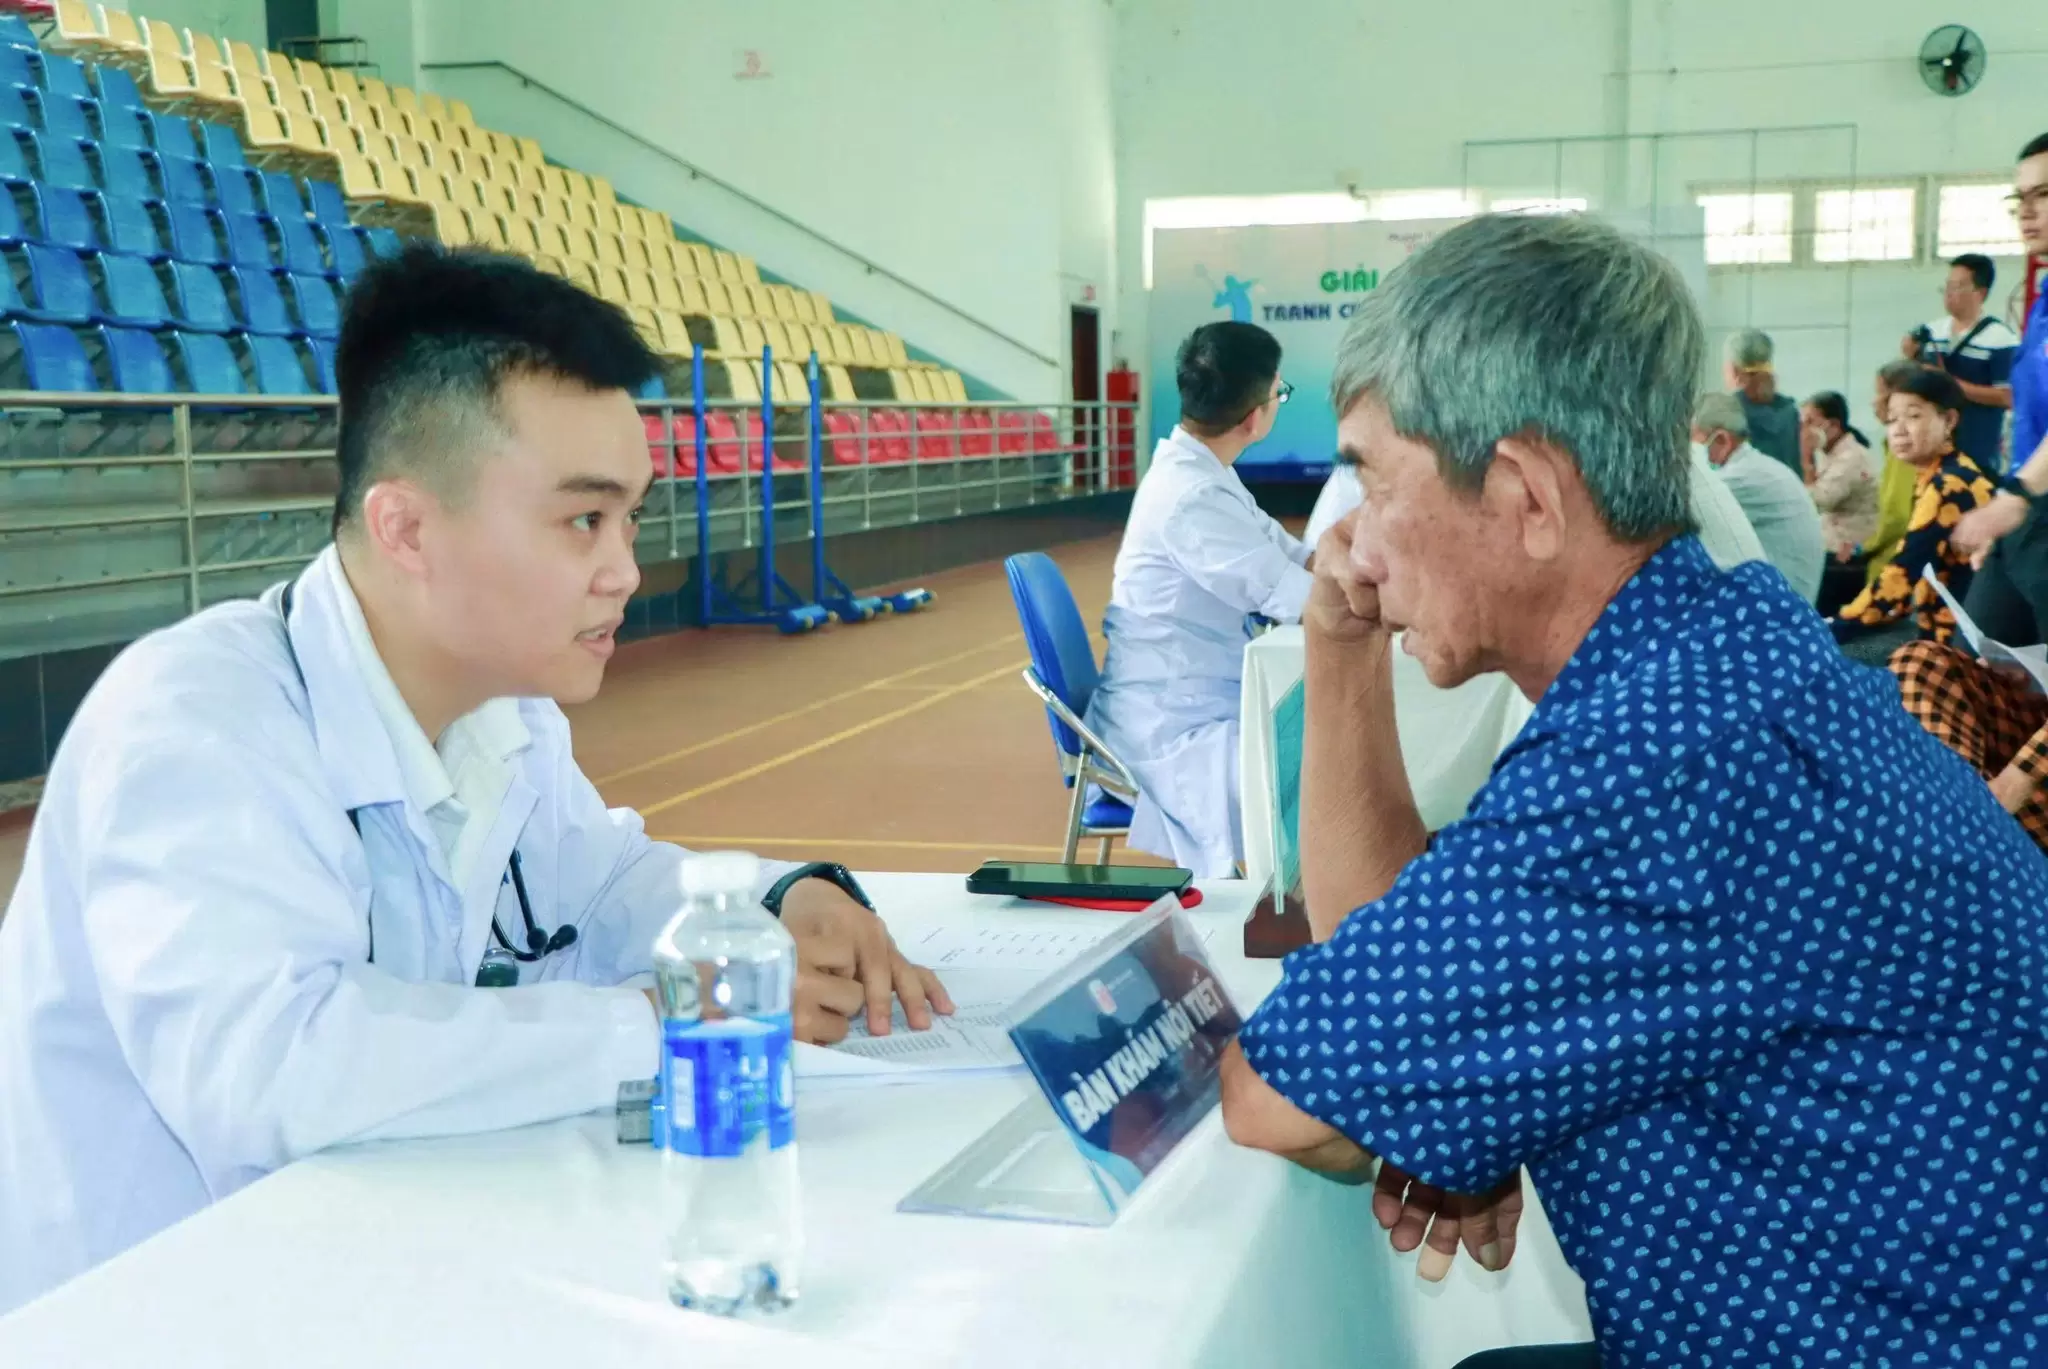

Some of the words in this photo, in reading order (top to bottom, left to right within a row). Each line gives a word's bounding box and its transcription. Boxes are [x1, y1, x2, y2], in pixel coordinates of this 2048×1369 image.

[1263, 303, 1331, 321] TRANH
[1062, 1068, 1120, 1132] BÀN
[1103, 1028, 1169, 1097] KHÁM
